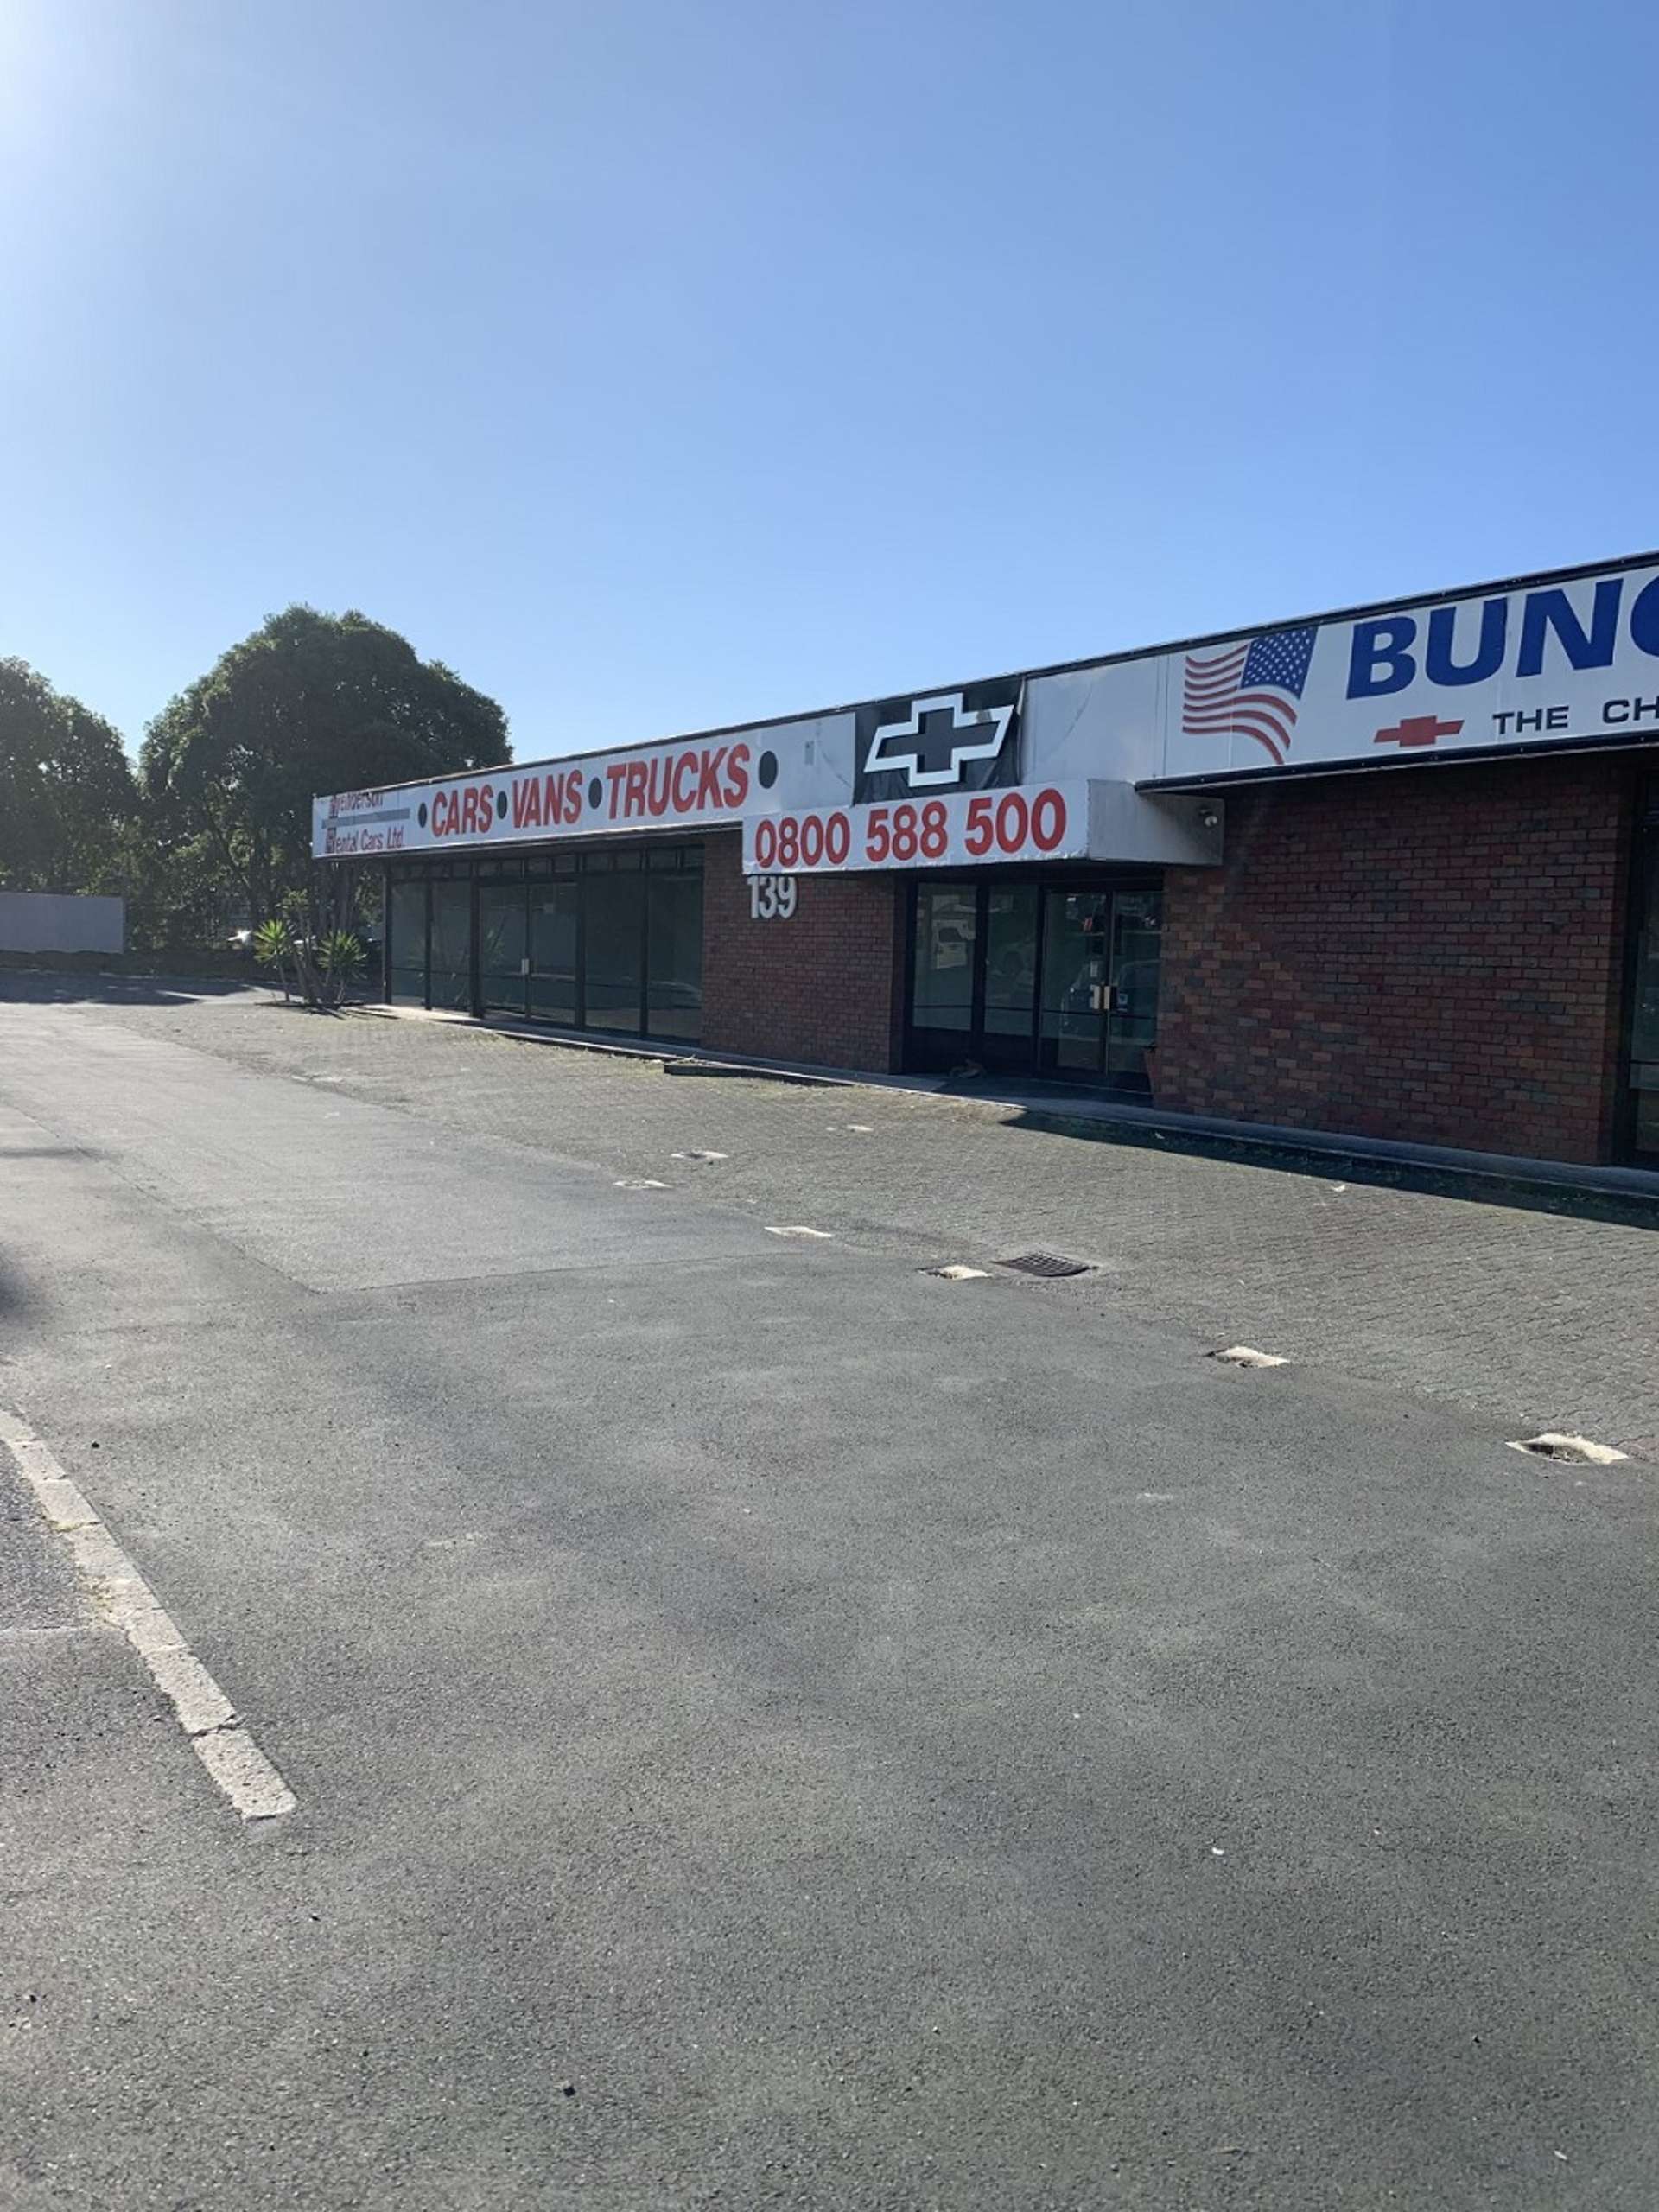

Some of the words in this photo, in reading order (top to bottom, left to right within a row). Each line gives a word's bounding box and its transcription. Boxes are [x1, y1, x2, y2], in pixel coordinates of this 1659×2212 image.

[1492, 705, 1570, 735] THE
[433, 784, 493, 837] CARS
[512, 770, 582, 828] VANS
[607, 743, 751, 820] TRUCKS
[755, 812, 851, 868] 0800
[866, 801, 948, 862] 588
[964, 788, 1067, 857] 500
[747, 875, 797, 918] 139
